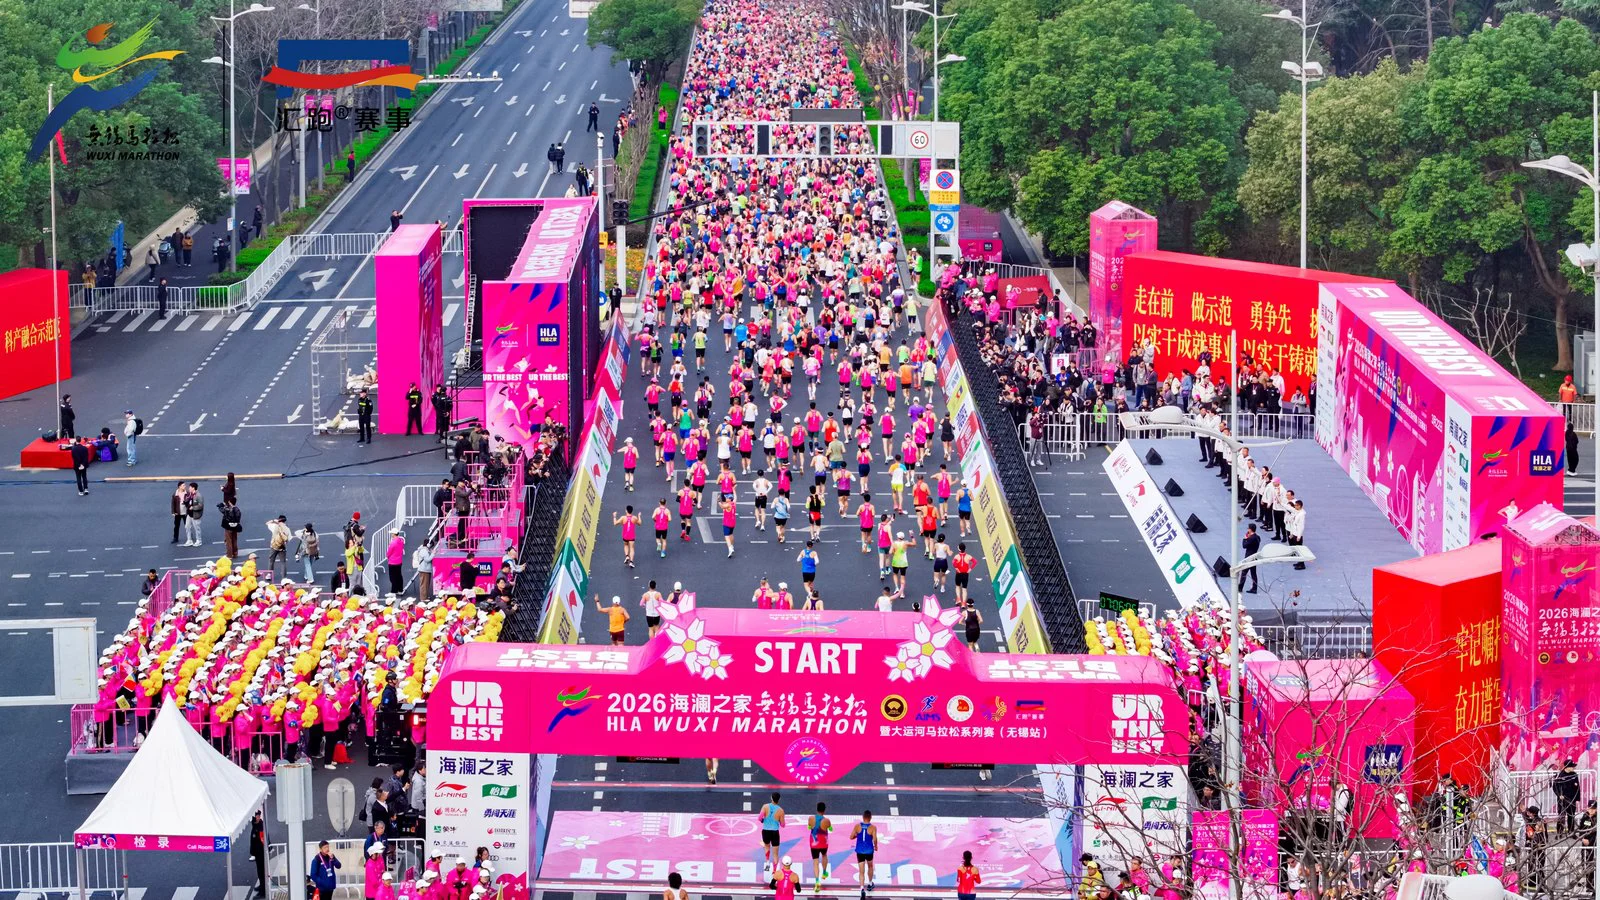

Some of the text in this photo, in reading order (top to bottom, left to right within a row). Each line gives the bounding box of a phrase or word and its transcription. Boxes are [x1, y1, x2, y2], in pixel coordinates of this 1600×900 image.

[914, 135, 926, 145] 60
[1133, 284, 1174, 319] 走在前
[1191, 291, 1232, 327] 做示范
[1250, 301, 1292, 335] 勇争先
[540, 328, 558, 337] HLA
[1369, 310, 1496, 377] UR THE BEST
[493, 373, 506, 381] THE
[507, 373, 522, 381] BEST
[528, 373, 538, 381] UR
[539, 373, 552, 381] THE
[1533, 455, 1552, 465] HLA
[499, 648, 629, 663] BEST
[755, 641, 862, 674] START
[989, 659, 1119, 673] BEST
[451, 680, 503, 707] UR
[607, 692, 752, 714] 2026海澜之家
[1112, 693, 1164, 720] UR
[451, 706, 503, 726] THE
[915, 713, 941, 722] AIMS
[450, 725, 503, 742] BEST
[607, 716, 867, 735] HLA WUXI MARATHON
[1111, 720, 1164, 738] THE
[1111, 739, 1164, 754] BEST
[439, 756, 514, 776] 海澜之家
[1100, 770, 1174, 789] 海澜之家
[134, 835, 170, 849] 检录
[570, 858, 714, 883] BEST
